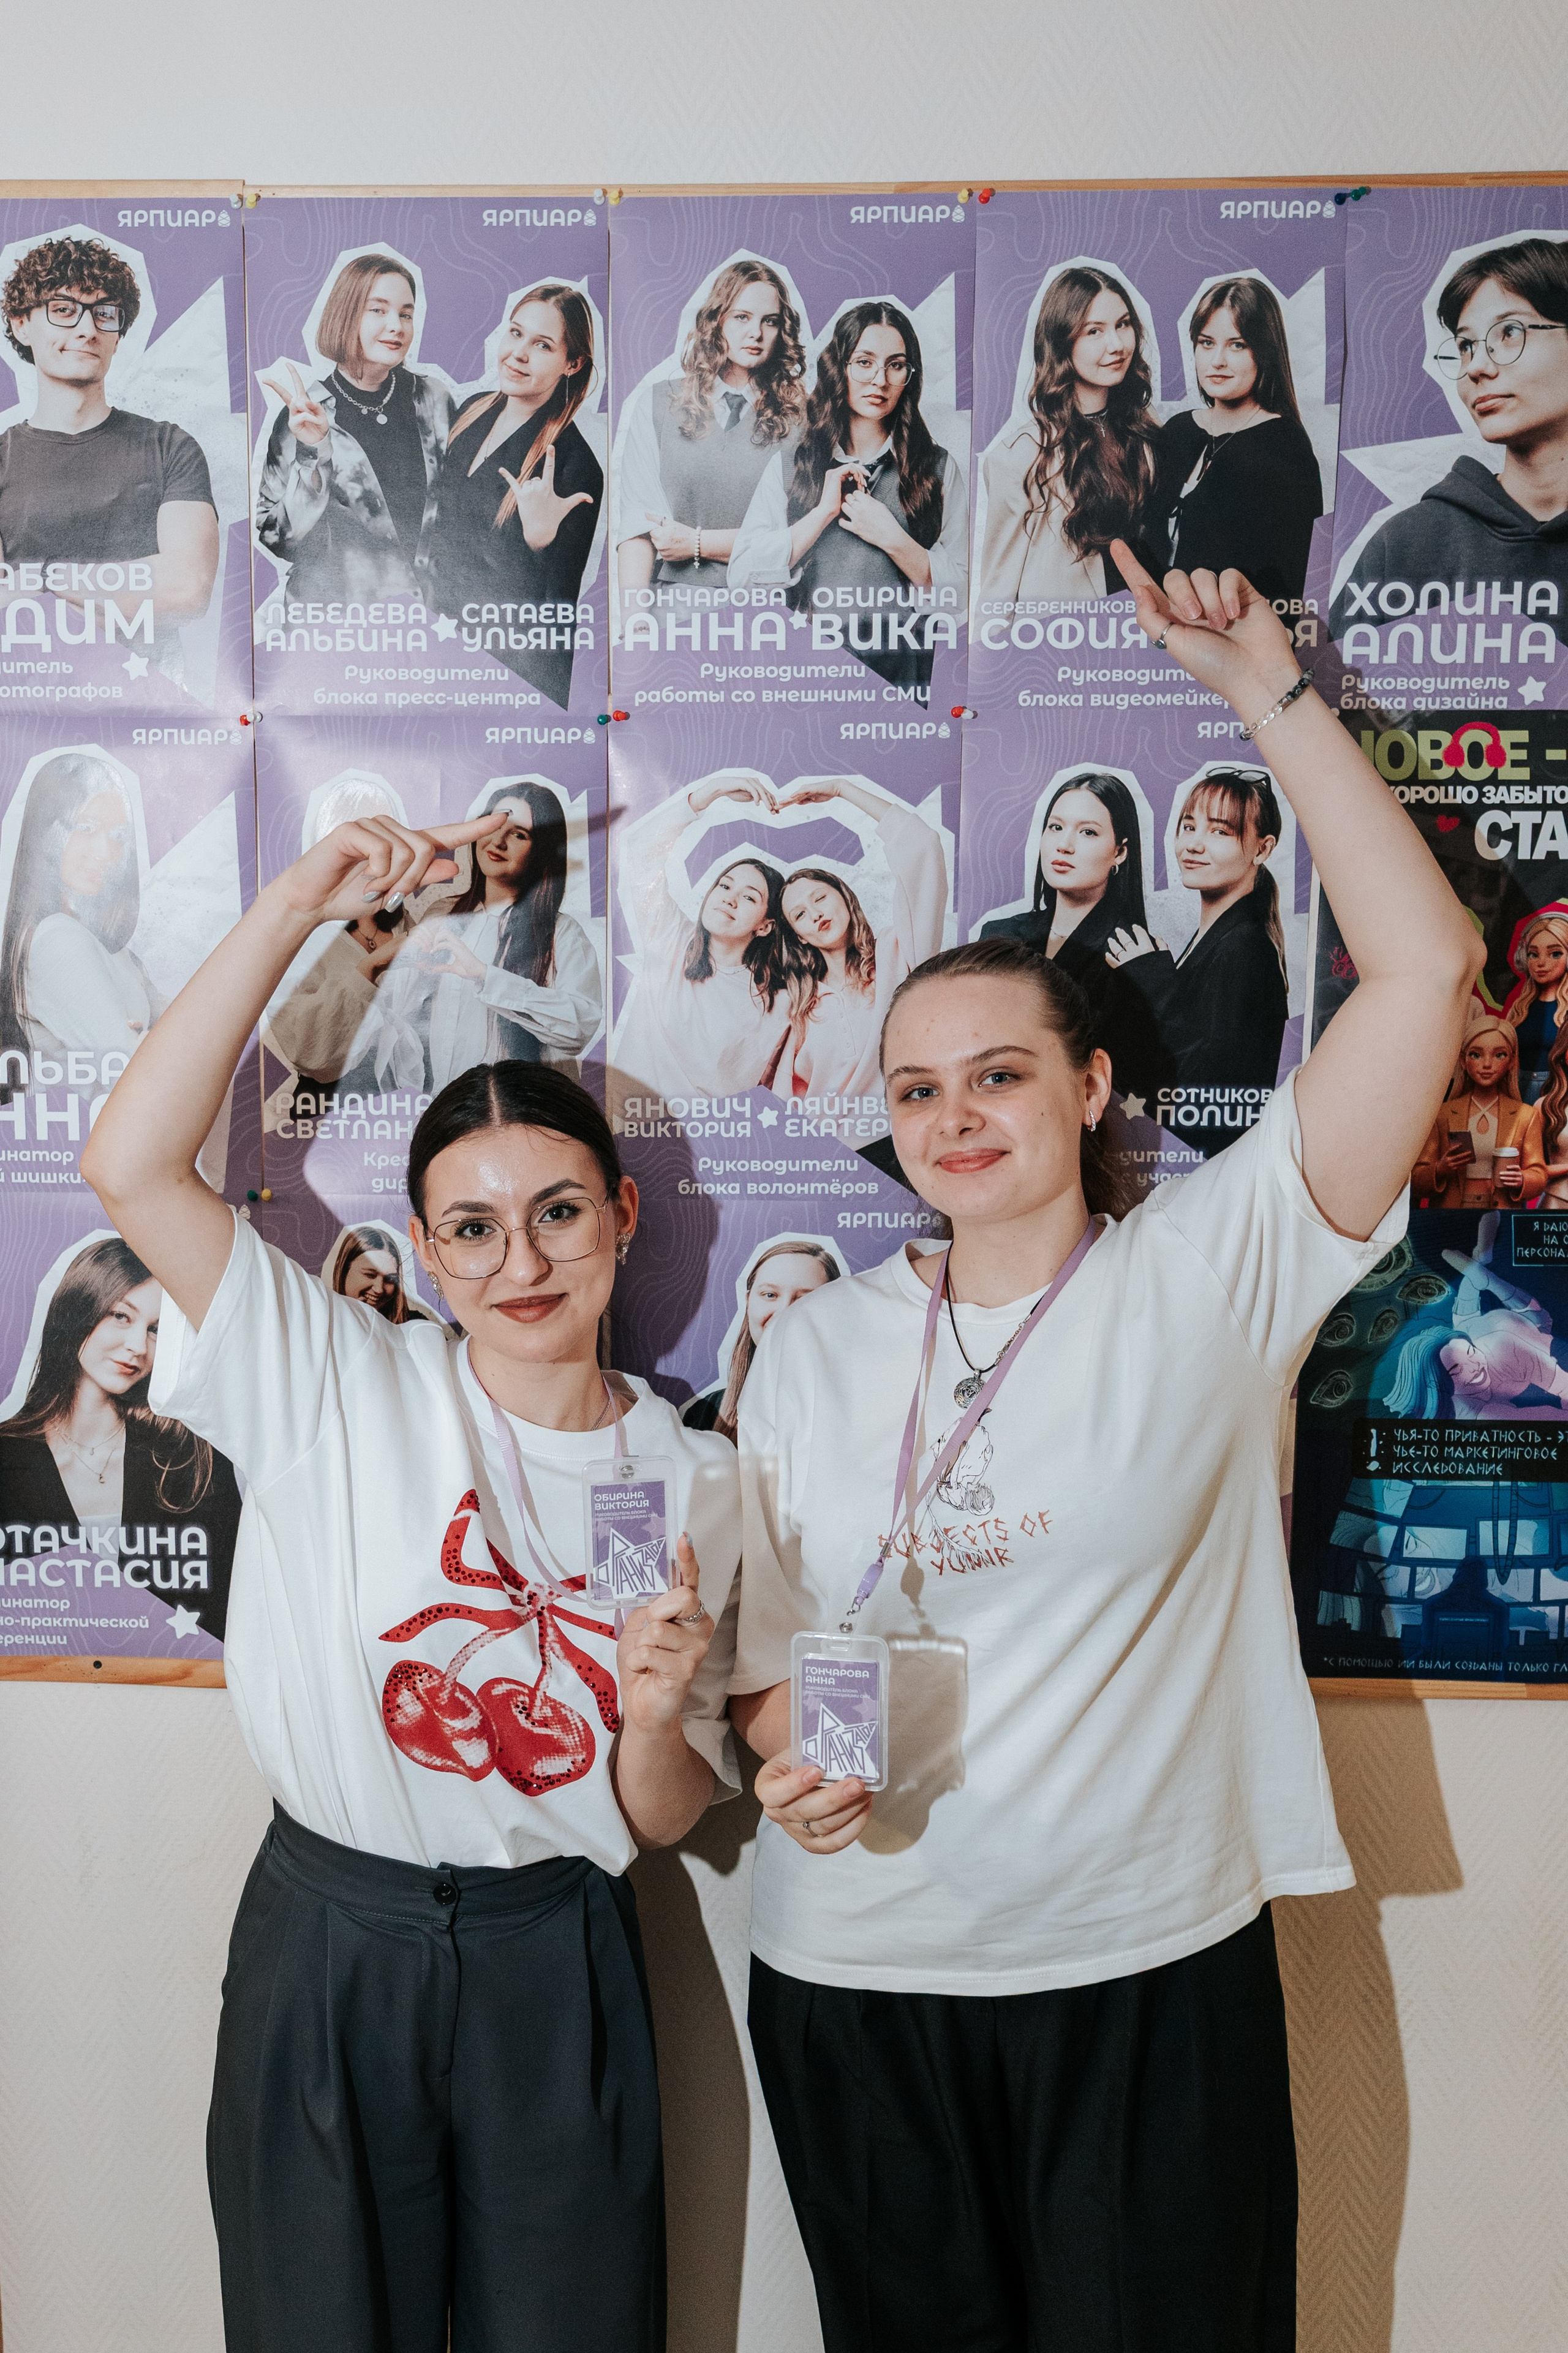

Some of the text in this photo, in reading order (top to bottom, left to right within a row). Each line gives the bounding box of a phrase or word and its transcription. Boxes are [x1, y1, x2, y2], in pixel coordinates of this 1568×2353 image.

[118, 209, 215, 228] ЯРПИАР
[483, 209, 582, 227] ЯРПИАР
[850, 206, 950, 224] ЯРПИАР
[1220, 200, 1321, 219] ЯРПИАР
[624, 587, 786, 608] ГОНЧАРОВА
[812, 586, 957, 608] ОБИРИНА
[1344, 580, 1559, 616] ХОЛИНА
[265, 603, 428, 628] ЛЕБЕДЕВА
[461, 603, 595, 624] САТАЕВА
[265, 629, 428, 652] АЛЬБИНА
[462, 627, 595, 653] УЛЬЯНА
[624, 611, 786, 652] АННА
[812, 612, 957, 651] ВИКА
[980, 617, 1148, 651] СОФИЯ
[1343, 622, 1556, 665] АЛИНА
[344, 665, 509, 684] Руководители
[700, 662, 865, 682] Руководители
[1341, 674, 1510, 693] Руководитель
[314, 688, 541, 708] блока пресс-центра
[635, 686, 930, 706] работы со внешними СМИ
[1017, 690, 1084, 707] блока
[1340, 693, 1508, 711] блока дизайна
[132, 728, 228, 746] ЯРПИАР
[485, 728, 582, 744] ЯРПИАР
[840, 723, 937, 739] ЯРПИАР
[624, 1097, 752, 1119] ЯНОВИЧ
[624, 1120, 752, 1138] ВИКТОРИЯ
[785, 1117, 892, 1138] ЕКАТЕР
[698, 1157, 859, 1176] Руководители
[677, 1178, 879, 1198] блока волонтёров
[837, 1212, 931, 1229] ЯРПИАР
[1517, 1247, 1568, 1258] ПЕРСОНА
[1394, 1429, 1439, 1441] ЧЬЯ-ТО
[1445, 1429, 1541, 1443] ПРИВАТНОСТЬ
[1444, 1446, 1557, 1460] МАРКЕТИНГОВОЕ
[1393, 1461, 1502, 1475] ИССЛЕДОВАНИЕ
[594, 1490, 644, 1501] ОБИРИНА
[594, 1499, 649, 1511] ВИКТОРИЯ
[1019, 1509, 1054, 1538] OF
[0, 1524, 208, 1555] ТАЧКИНА
[0, 1558, 208, 1589] АСТАСИЯ
[0, 1598, 70, 1612] инатор
[0, 1615, 149, 1630] о-практической
[805, 1666, 870, 1679] ГОНЧАРОВА
[1508, 1662, 1550, 1672] ТОЛЬКО
[805, 1675, 835, 1685] АННА
